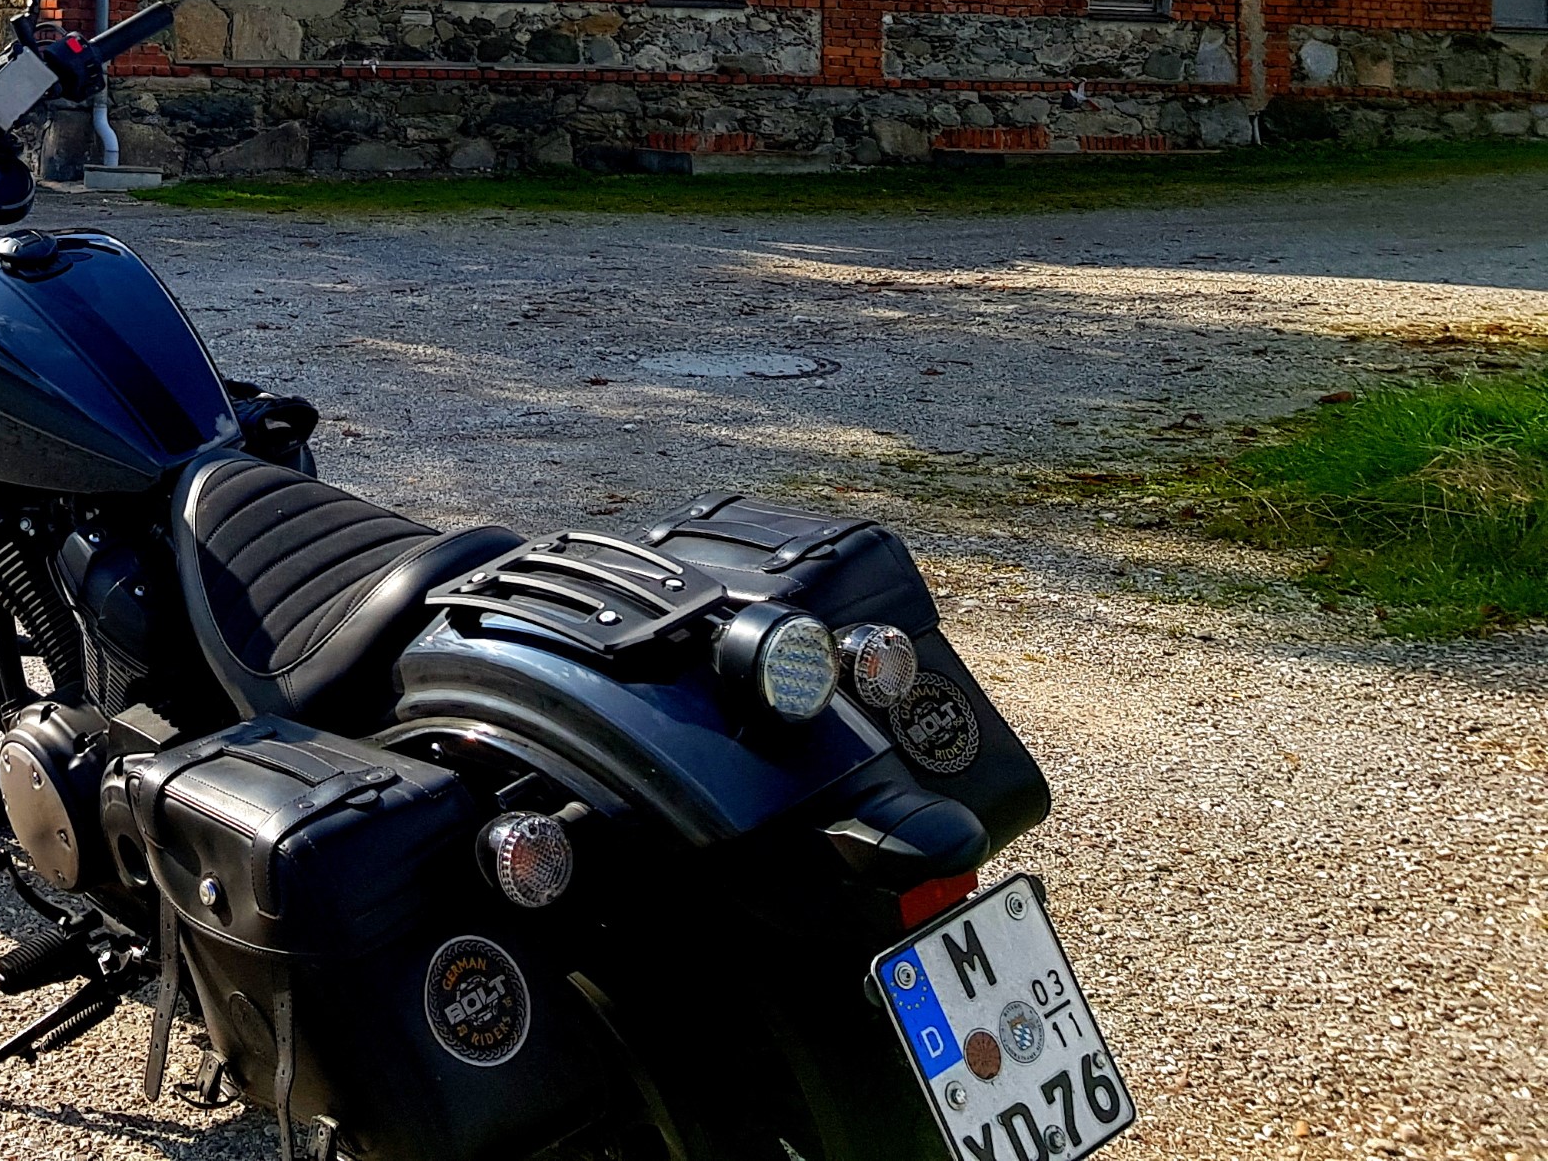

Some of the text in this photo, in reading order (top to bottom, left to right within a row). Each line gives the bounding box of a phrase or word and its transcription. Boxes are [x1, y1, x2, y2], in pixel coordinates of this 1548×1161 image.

[900, 685, 940, 719] GERMAN
[907, 701, 957, 744] BOLT
[934, 731, 968, 760] RIDERS
[442, 957, 487, 991] GERMAN
[941, 920, 997, 1000] M
[444, 974, 506, 1025] BOLT
[1031, 969, 1065, 1007] 03
[471, 1016, 512, 1046] RIDERS
[921, 1026, 944, 1058] D
[1052, 1011, 1083, 1048] 11
